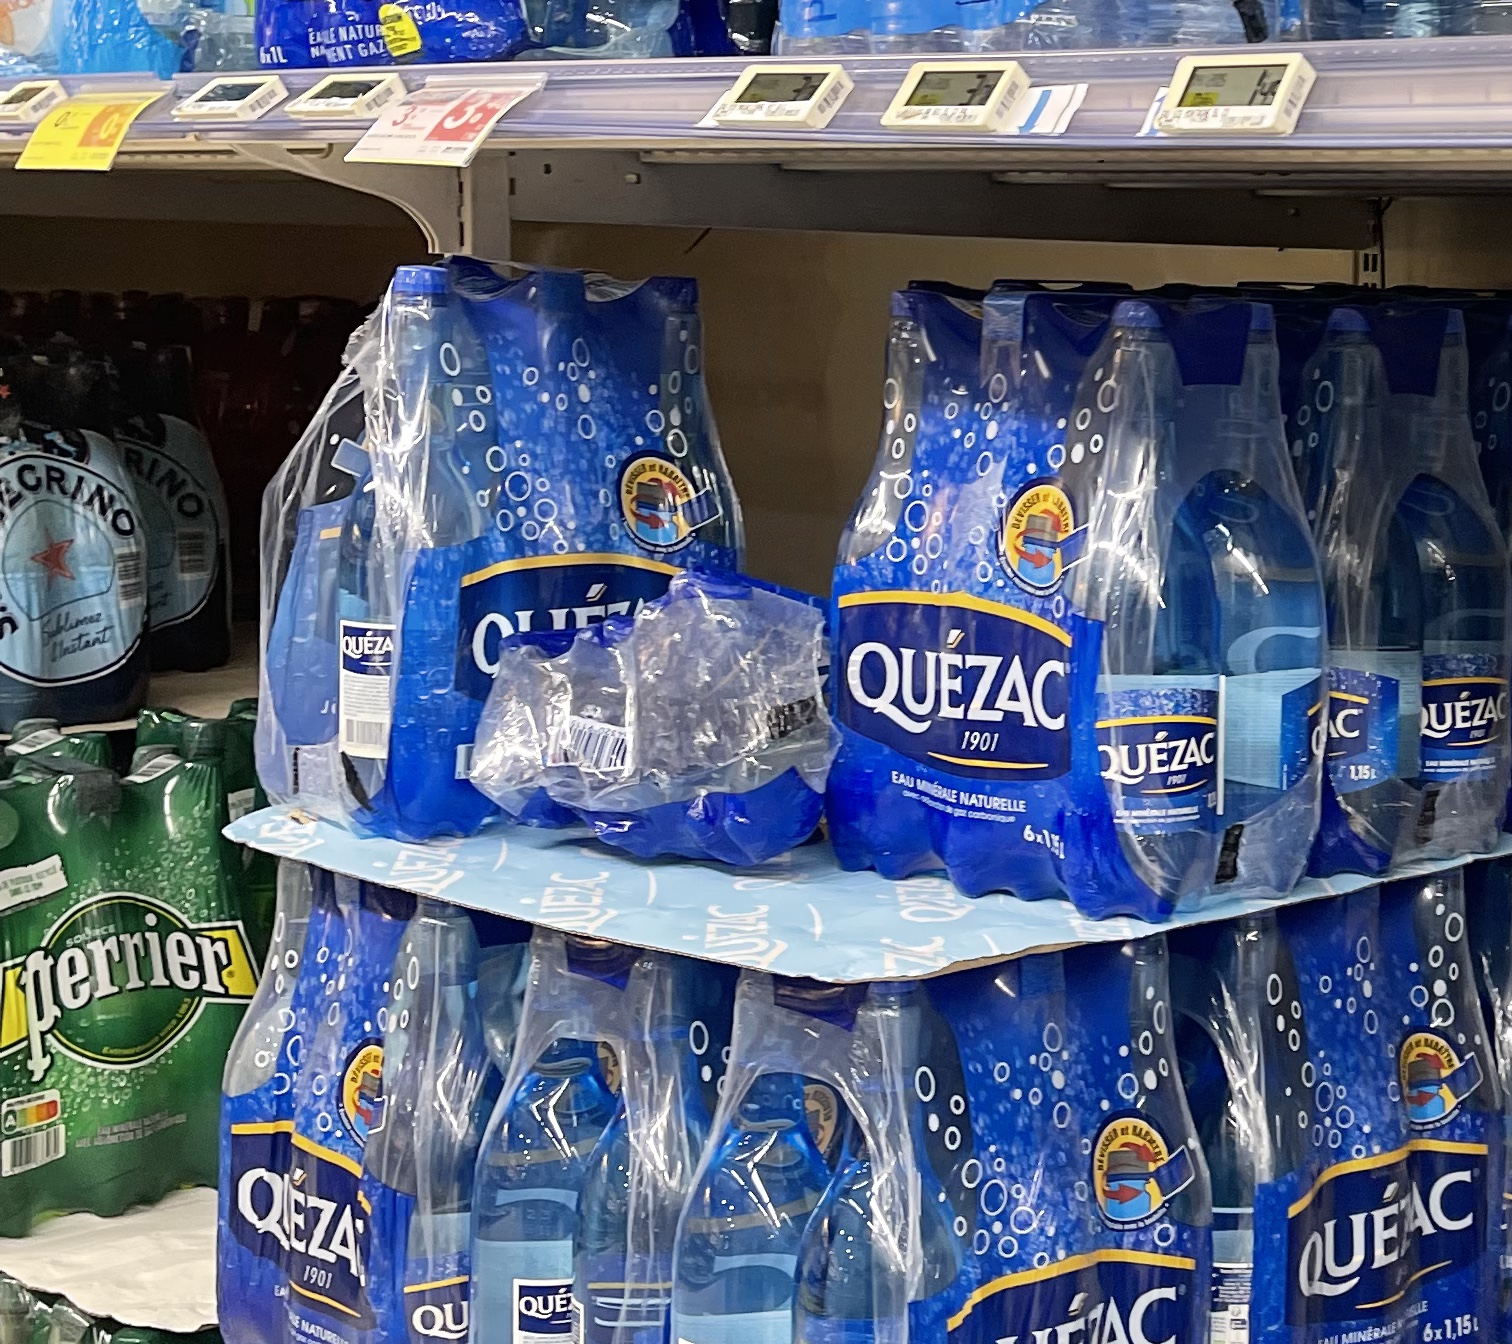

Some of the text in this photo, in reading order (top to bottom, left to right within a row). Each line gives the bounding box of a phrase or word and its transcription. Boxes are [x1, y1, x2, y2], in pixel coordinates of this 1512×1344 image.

[847, 628, 1067, 735] QUÉZAC
[1420, 691, 1508, 738] QUÉZAC
[960, 730, 1001, 753] 1901
[1097, 731, 1216, 786] QUÉZAC
[890, 770, 915, 788] EAU
[959, 790, 1027, 813] NATURELLE
[1299, 1170, 1474, 1297] QUÉAC
[303, 1264, 334, 1290] 1901
